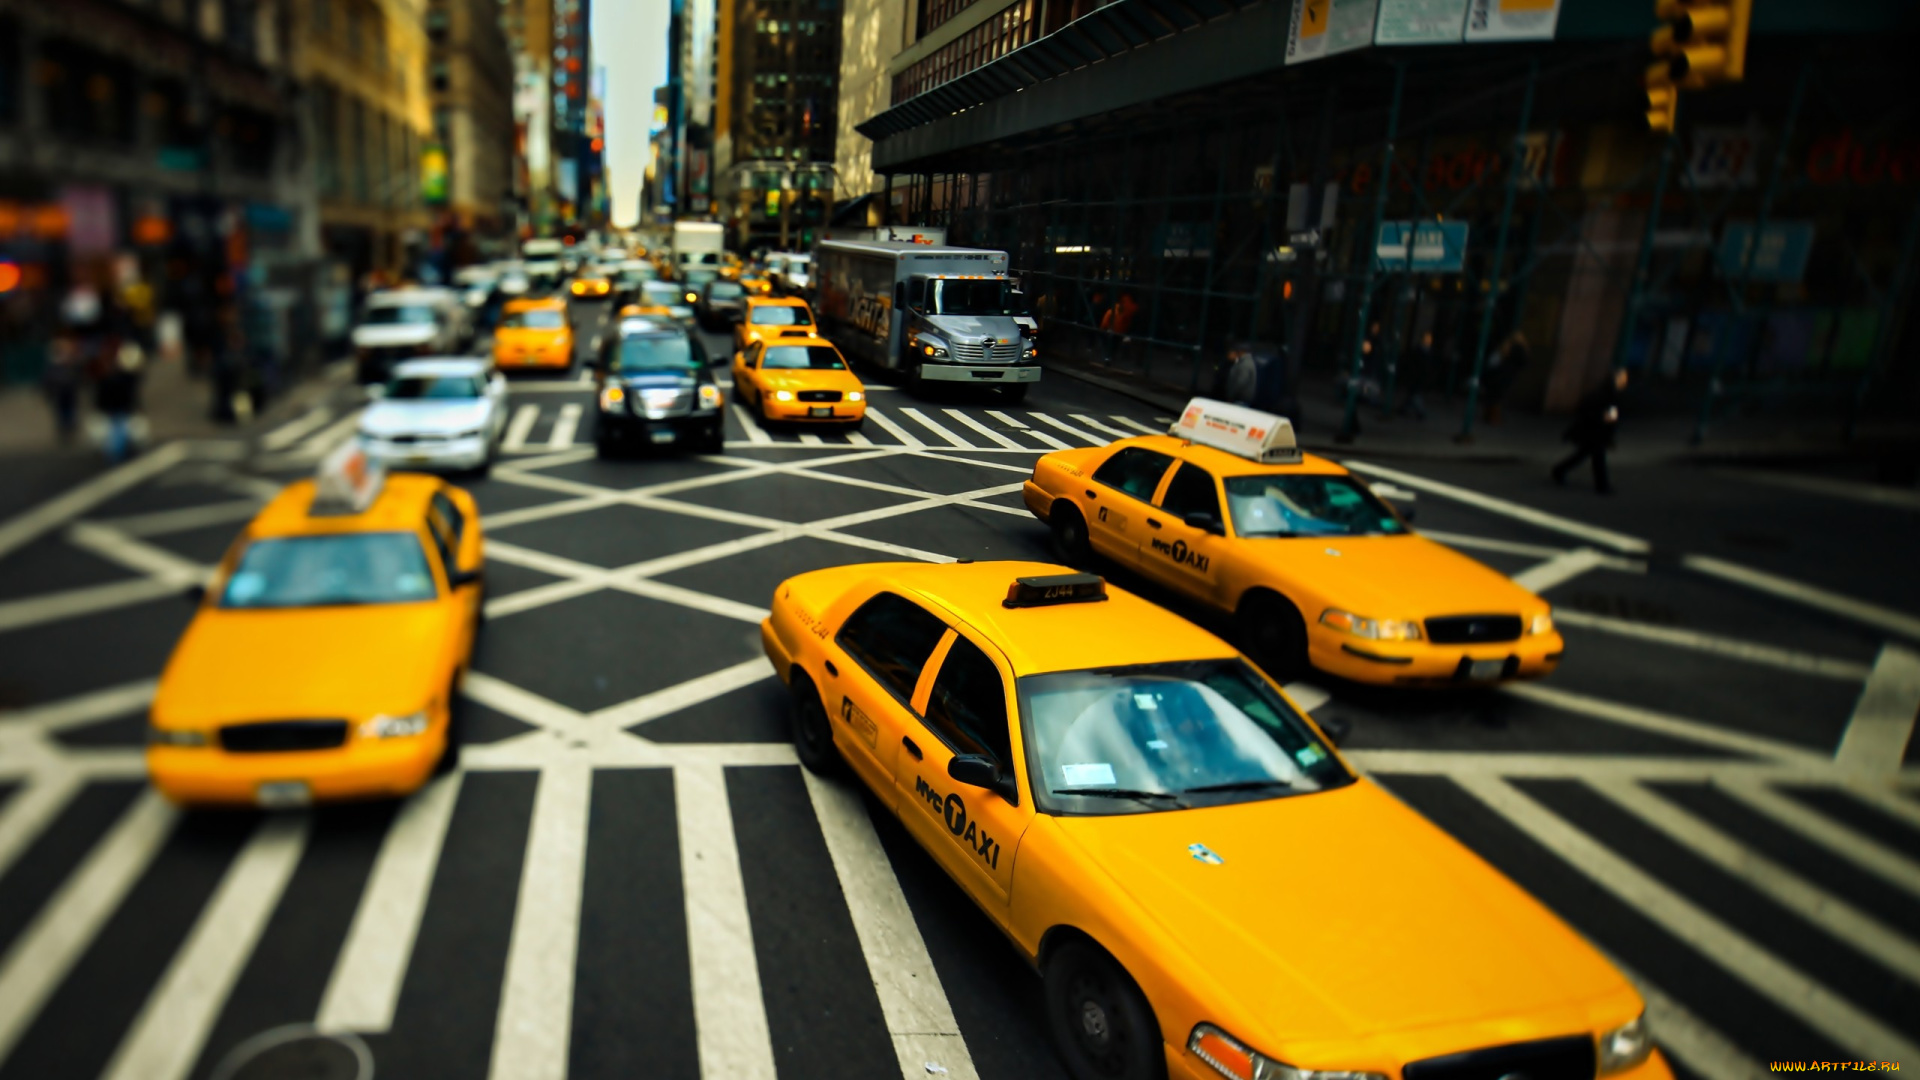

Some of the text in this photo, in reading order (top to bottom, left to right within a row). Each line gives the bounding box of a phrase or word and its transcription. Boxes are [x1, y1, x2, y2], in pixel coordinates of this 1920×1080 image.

[1151, 537, 1209, 574] NYC TAXI
[916, 775, 1000, 870] NYC TAXI
